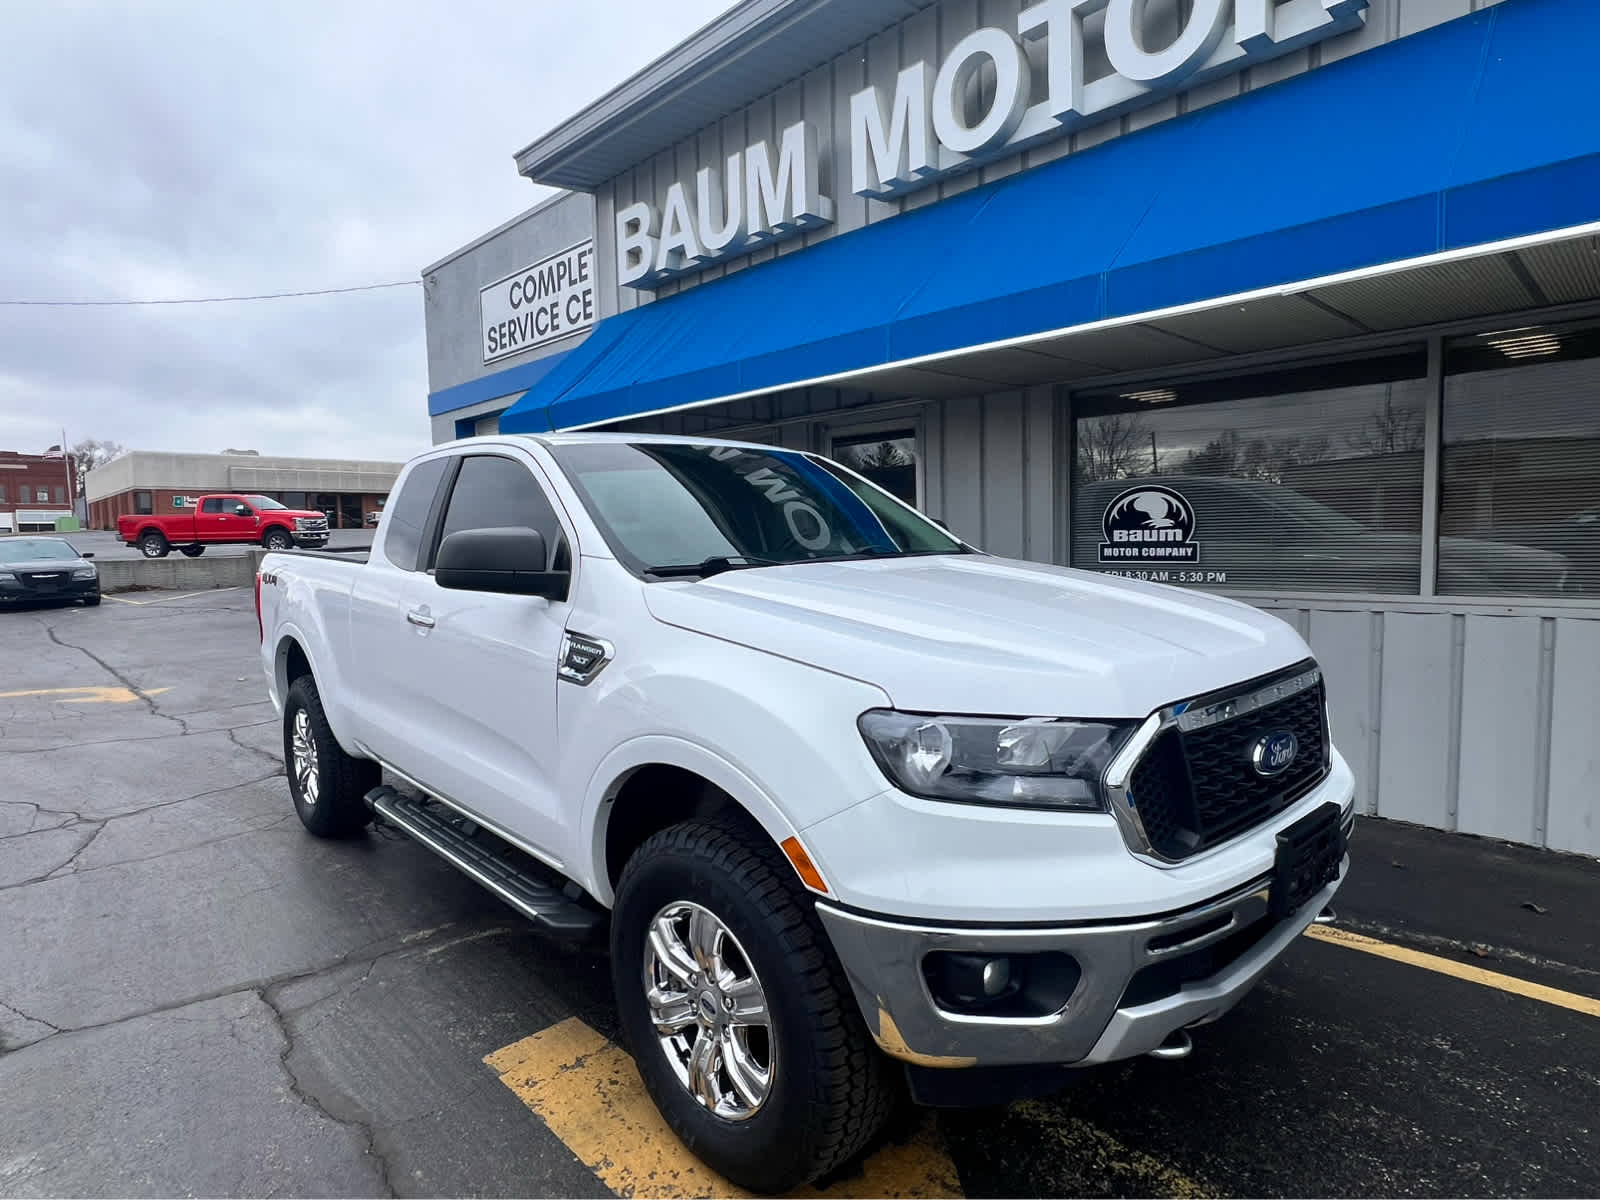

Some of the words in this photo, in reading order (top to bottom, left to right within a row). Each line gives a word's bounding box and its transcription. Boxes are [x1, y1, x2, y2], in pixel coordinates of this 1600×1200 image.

[616, 120, 818, 288] BAUM
[850, 0, 1370, 196] MOTO
[487, 301, 560, 354] SERVICE
[1103, 547, 1139, 557] MOTOR
[1141, 547, 1193, 557] COMPANY
[1150, 571, 1169, 581] AM
[1179, 571, 1203, 582] 5:30
[1207, 572, 1227, 583] PM
[1271, 738, 1293, 766] Ford
